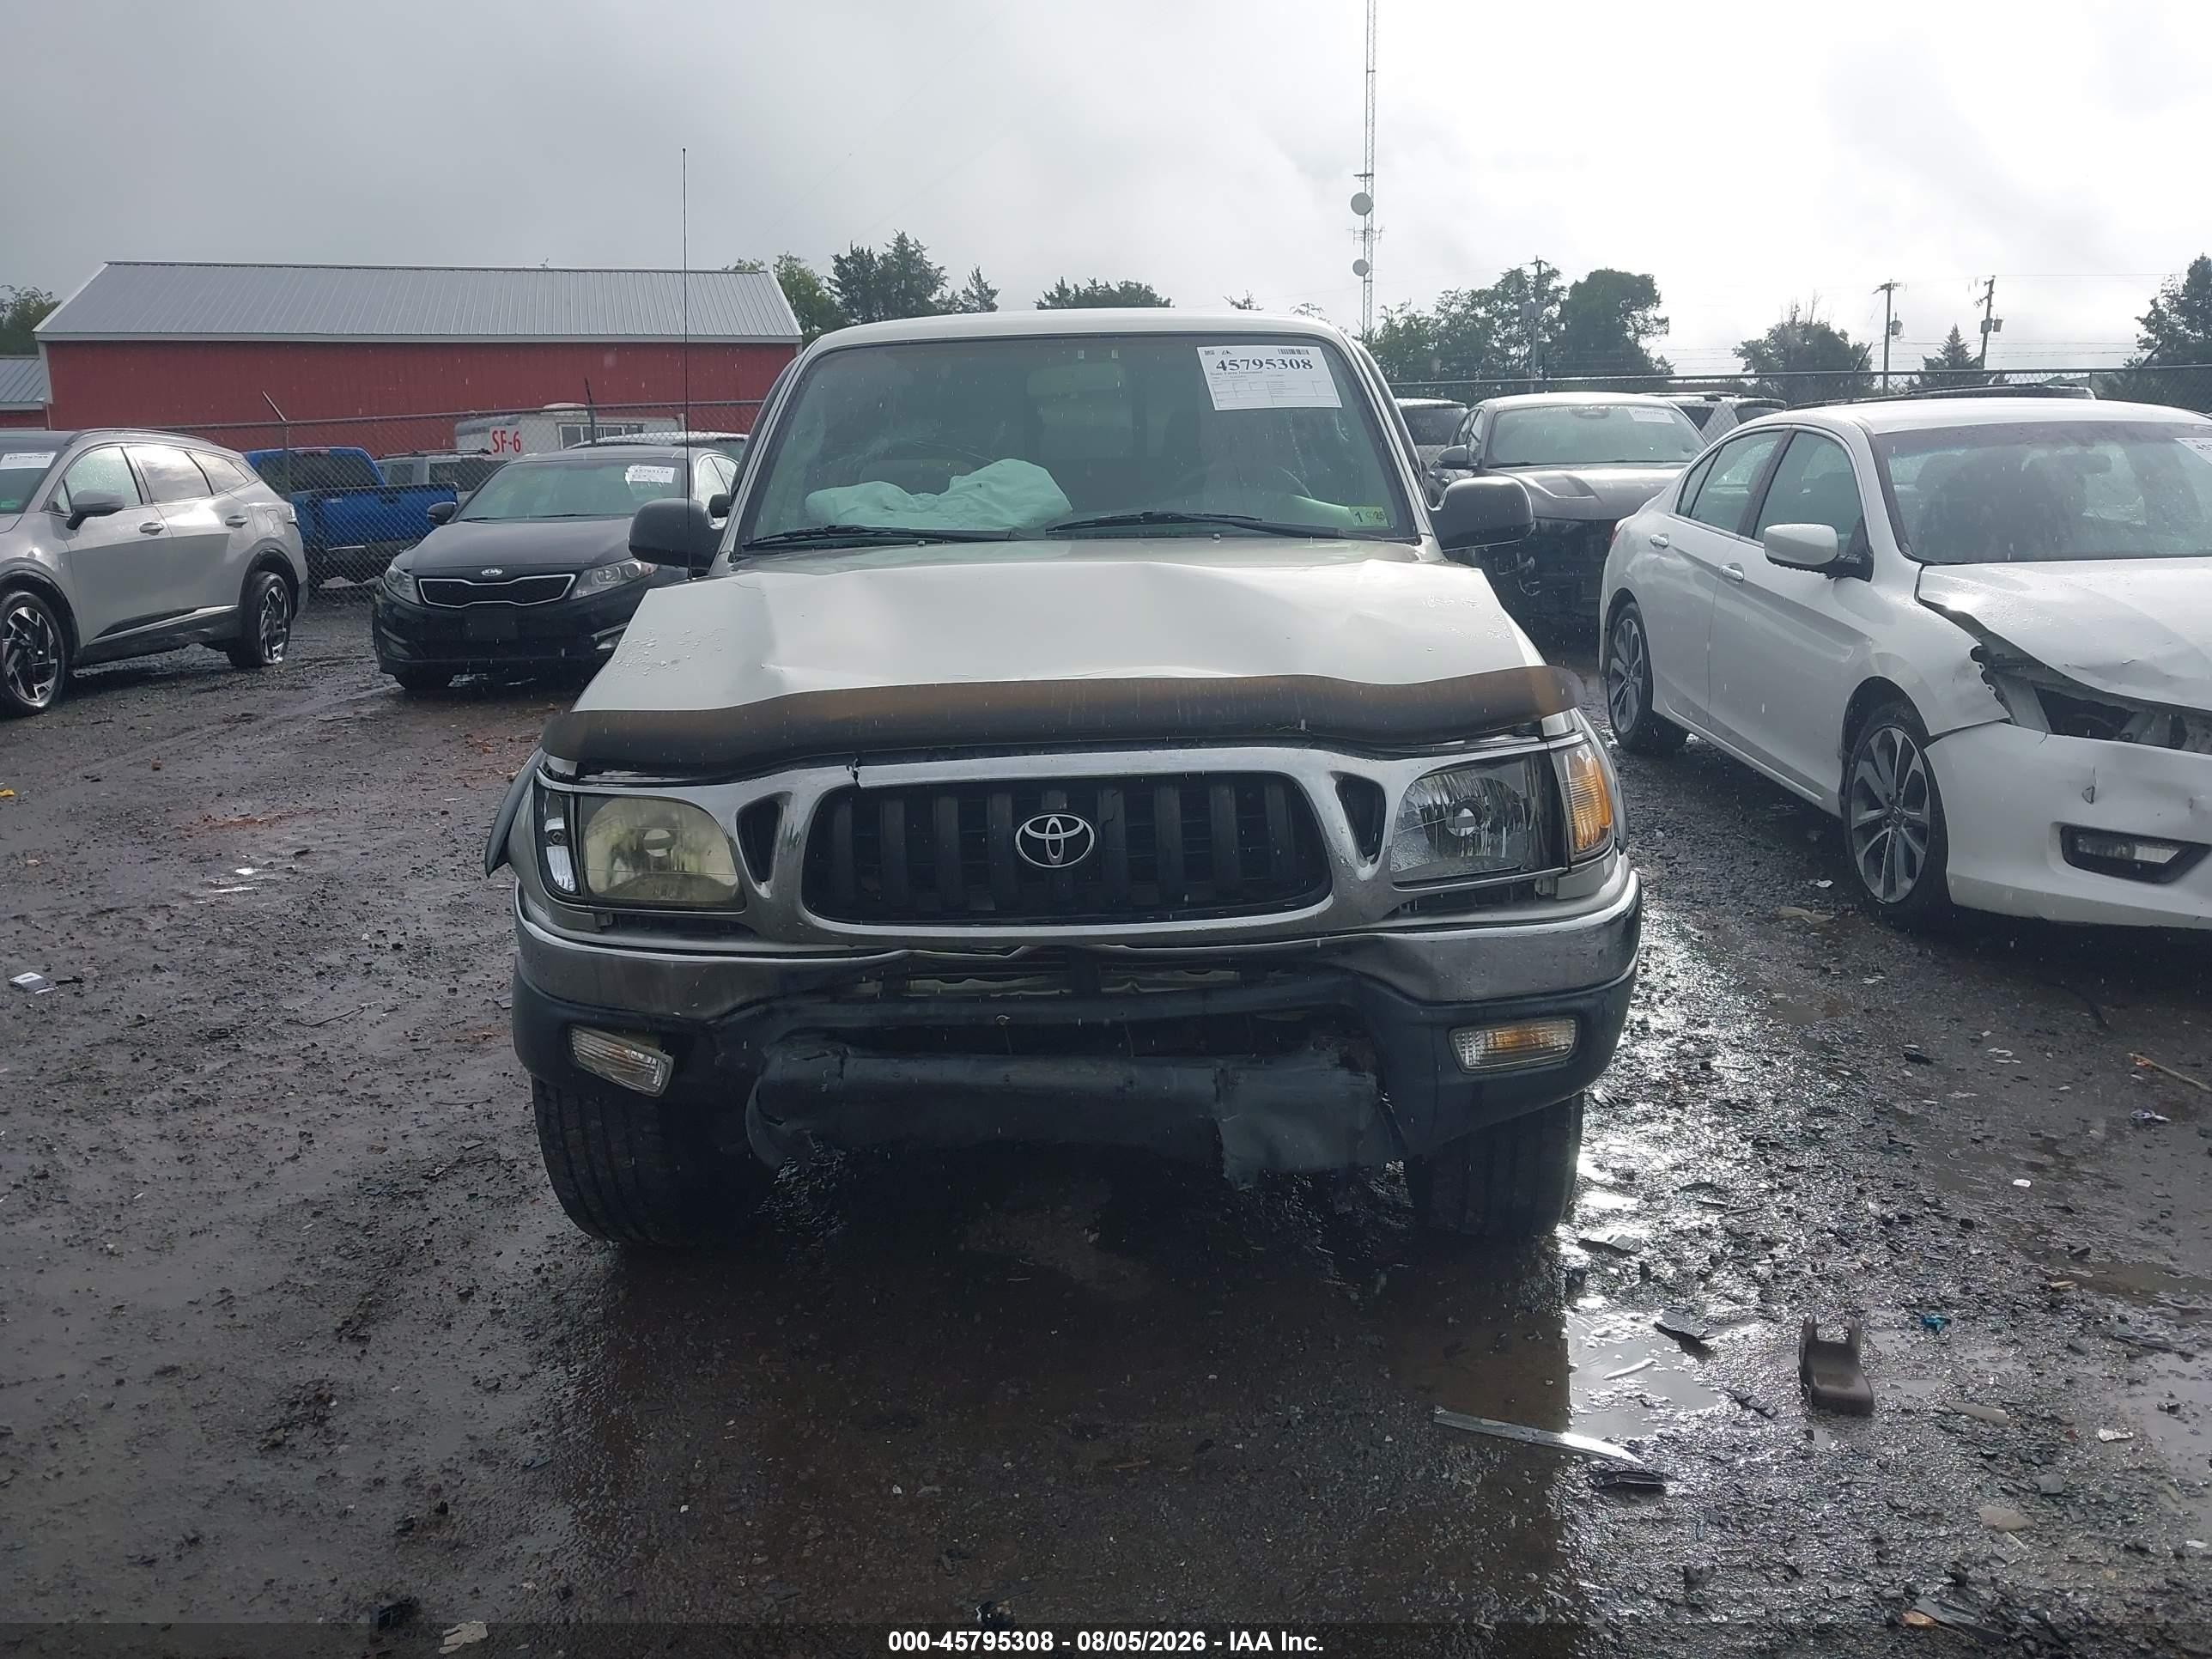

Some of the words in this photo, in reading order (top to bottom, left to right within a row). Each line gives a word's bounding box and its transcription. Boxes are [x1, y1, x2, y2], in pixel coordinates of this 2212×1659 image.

[1216, 358, 1313, 371] 45795308
[492, 430, 520, 453] SF-6
[1355, 511, 1363, 522] 1
